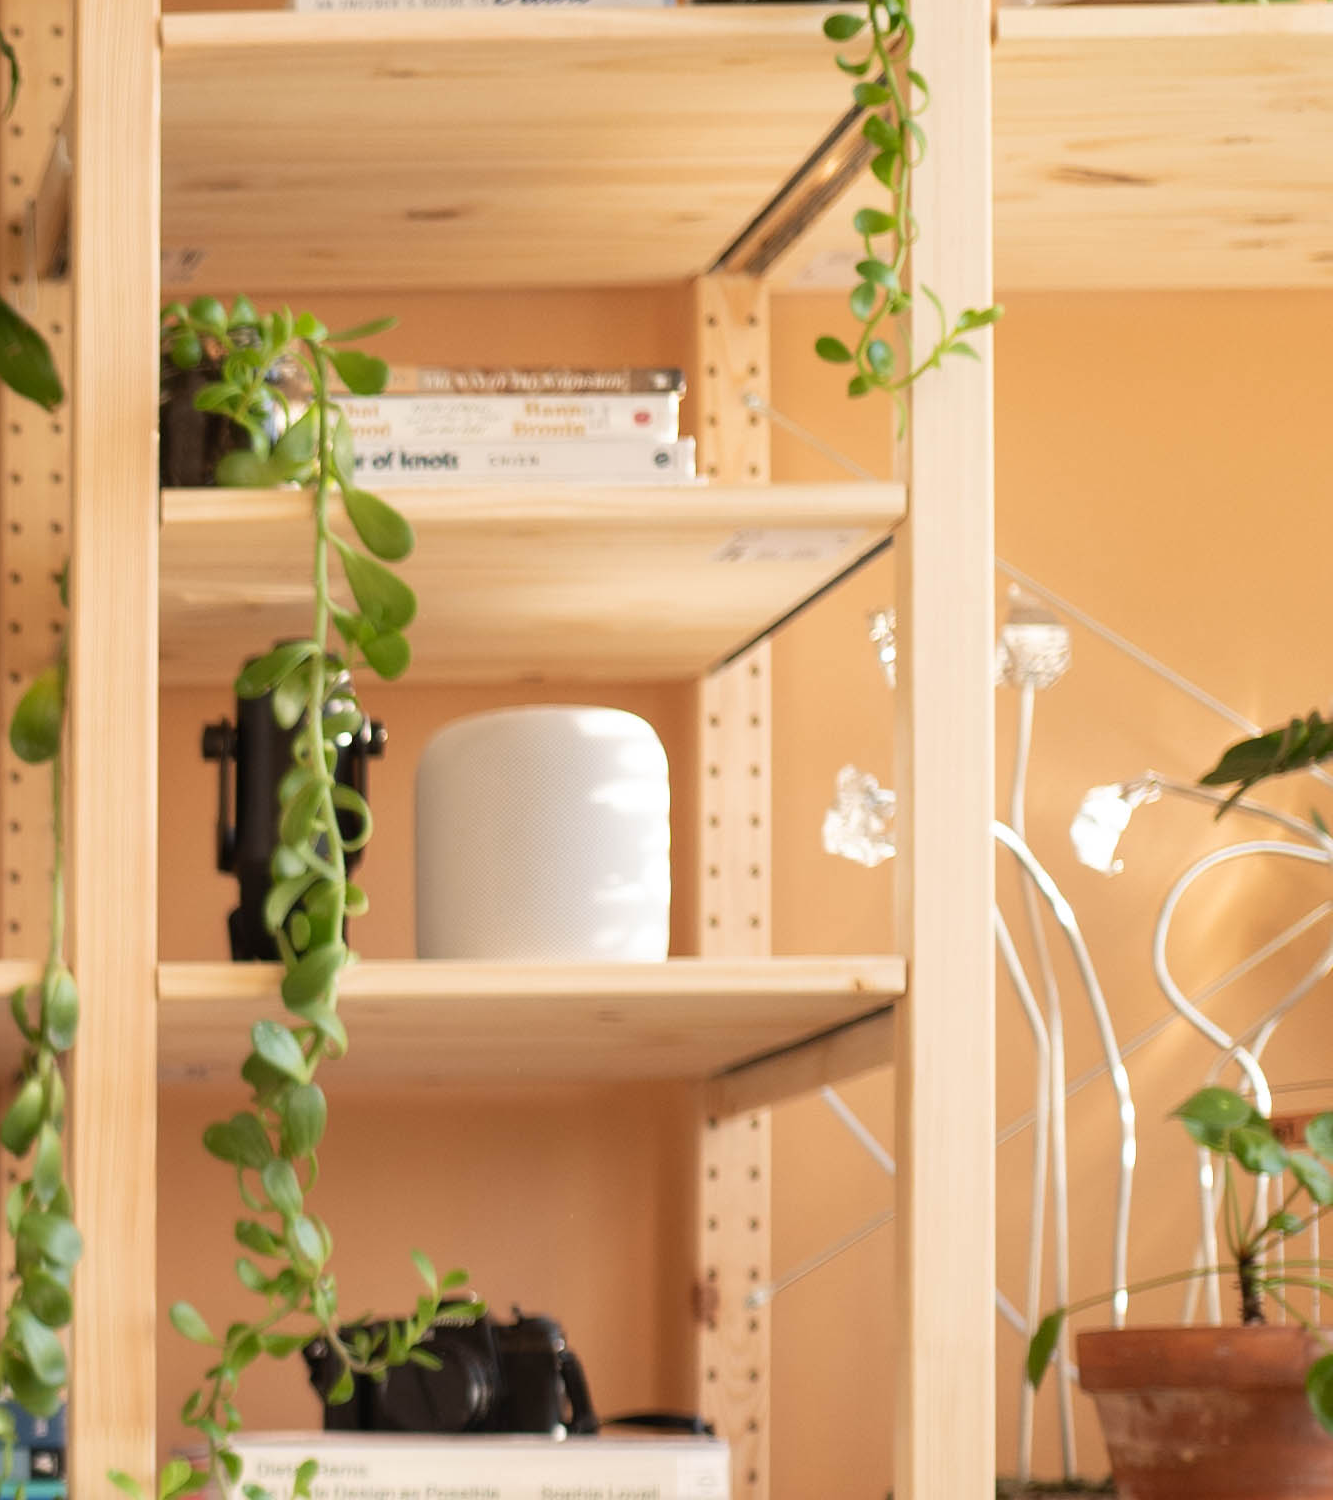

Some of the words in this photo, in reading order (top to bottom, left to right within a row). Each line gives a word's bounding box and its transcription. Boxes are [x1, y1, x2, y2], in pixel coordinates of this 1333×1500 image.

[373, 451, 394, 469] of
[401, 452, 458, 469] knots
[426, 1485, 501, 1500] Possible
